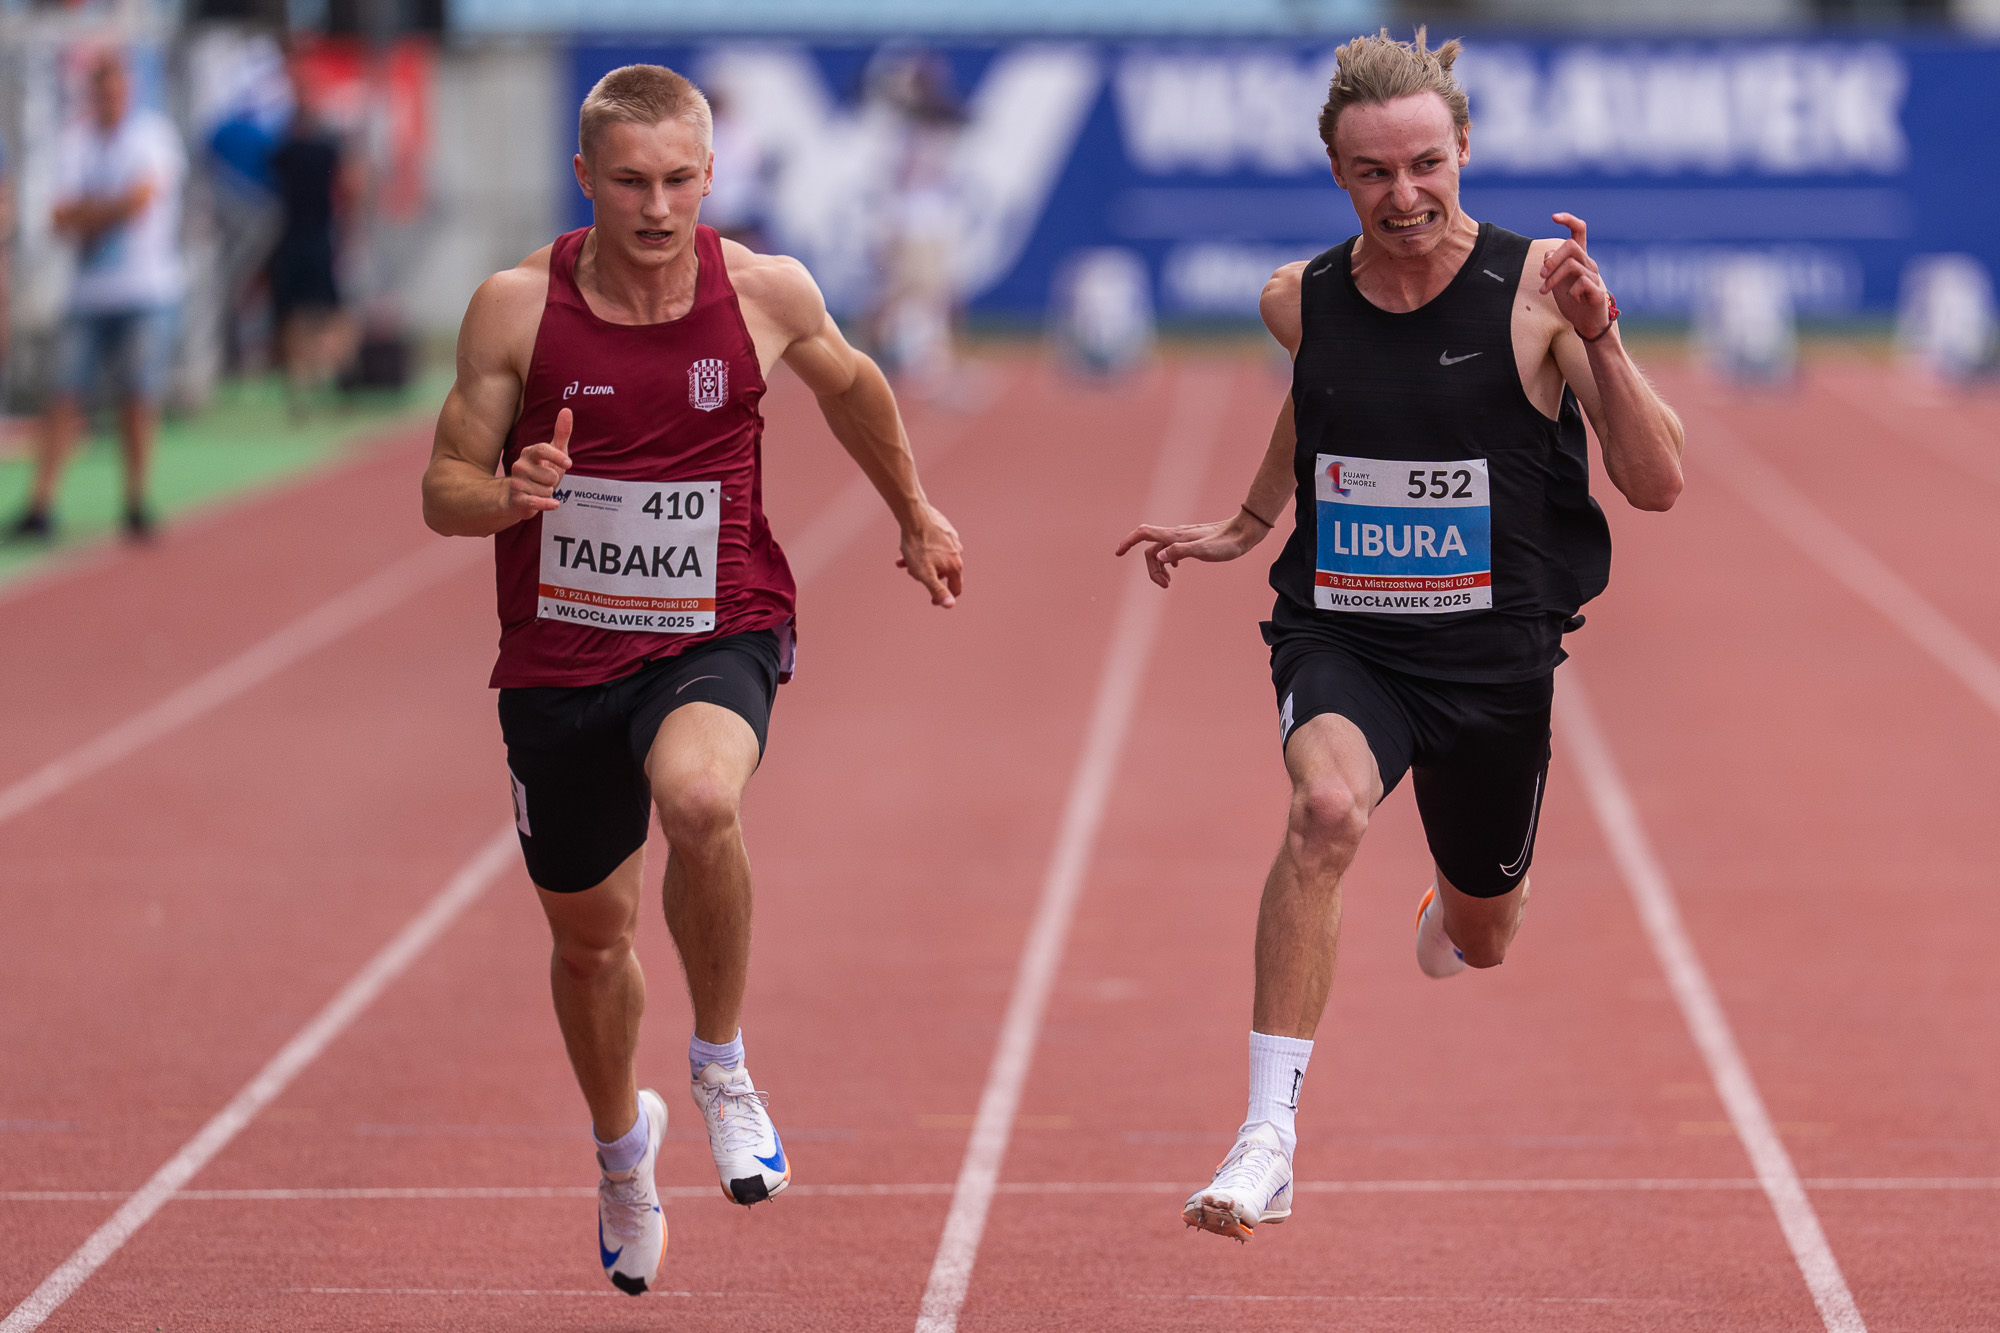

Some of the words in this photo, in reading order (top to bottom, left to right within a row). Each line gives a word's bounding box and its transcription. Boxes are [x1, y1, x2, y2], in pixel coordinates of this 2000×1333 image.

[583, 385, 615, 395] CUNA
[1343, 471, 1370, 480] KUJAWY
[1343, 478, 1377, 488] POMORZE
[1407, 469, 1473, 499] 552
[574, 490, 623, 503] WŁOCŁAWEK
[642, 491, 704, 520] 410
[1334, 520, 1468, 558] LIBURA
[553, 535, 703, 578] TABAKA
[1328, 576, 1341, 586] 79.
[1342, 578, 1363, 588] PZLA
[1364, 579, 1423, 589] Mistrzostwa
[1425, 578, 1454, 589] Polski
[1455, 576, 1475, 587] U20
[554, 588, 567, 598] 79.
[569, 591, 590, 602] PZLA
[592, 594, 649, 608] Mistrzostwa
[651, 599, 679, 609] Polski
[681, 600, 699, 609] U20
[1330, 592, 1430, 608] WŁOCŁAWEK
[1433, 593, 1472, 607] 2025
[555, 604, 654, 627] WŁOCŁAWEK
[657, 616, 695, 628] 2025
